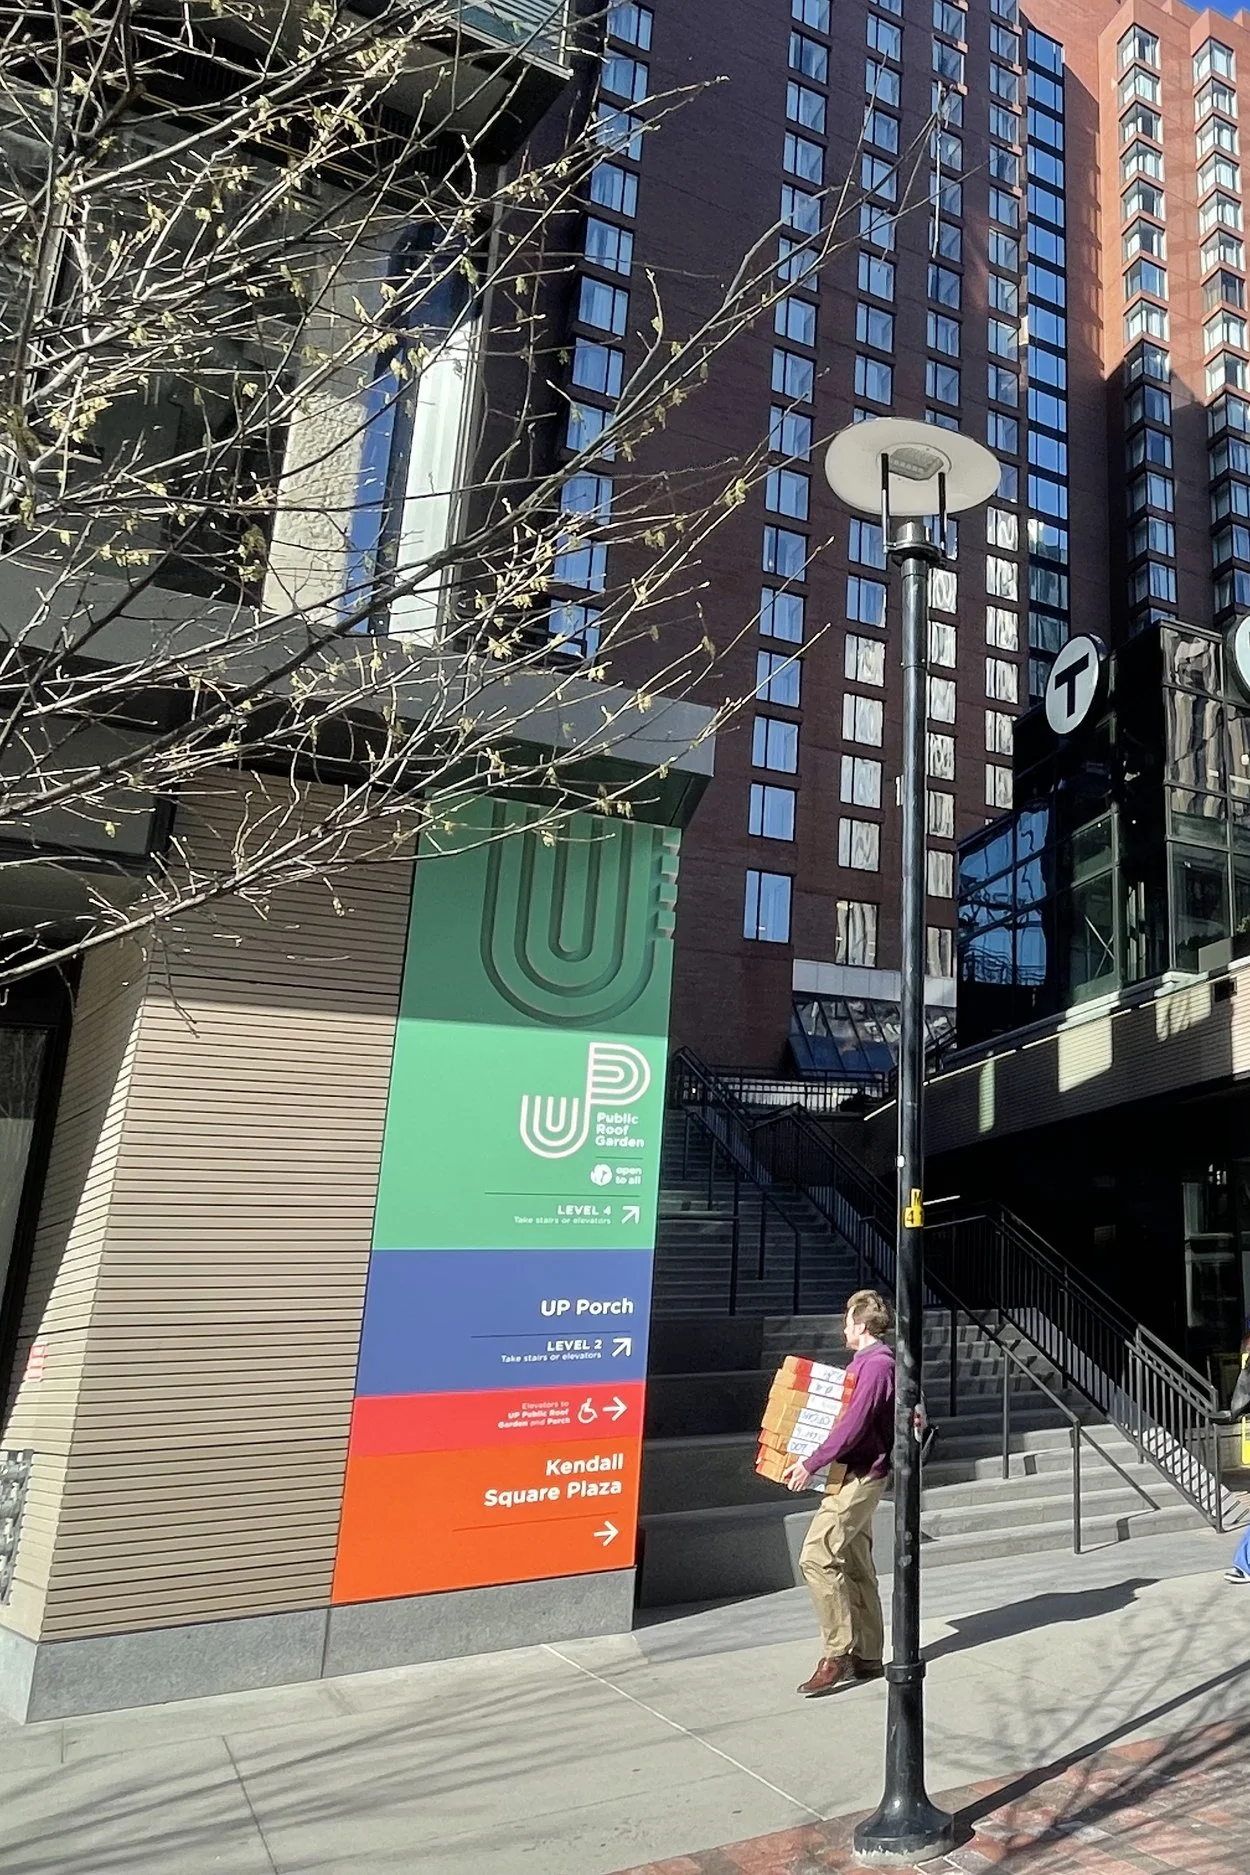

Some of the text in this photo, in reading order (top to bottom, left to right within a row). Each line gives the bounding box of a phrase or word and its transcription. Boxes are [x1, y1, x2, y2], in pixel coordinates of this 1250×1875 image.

[1055, 653, 1090, 718] T
[597, 1112, 639, 1124] Public
[596, 1124, 629, 1136] Roof
[595, 1135, 645, 1148] Garden
[616, 1166, 642, 1176] open
[616, 1175, 642, 1185] to all
[557, 1205, 612, 1216] LEVEL 4
[514, 1216, 533, 1224] Take
[535, 1216, 559, 1224] stairs
[572, 1217, 612, 1225] elevators
[540, 1297, 634, 1316] UP Porch
[547, 1339, 602, 1352] LEVEL 2
[501, 1354, 521, 1363] Take
[524, 1354, 548, 1362] stairs
[562, 1352, 602, 1361] elevators
[522, 1401, 559, 1409] Elevators
[508, 1408, 569, 1419] UP Public Roof
[498, 1420, 529, 1429] Garden
[547, 1417, 570, 1425] Porch
[546, 1453, 624, 1476] Kendall
[483, 1480, 622, 1508] Square Plaza
